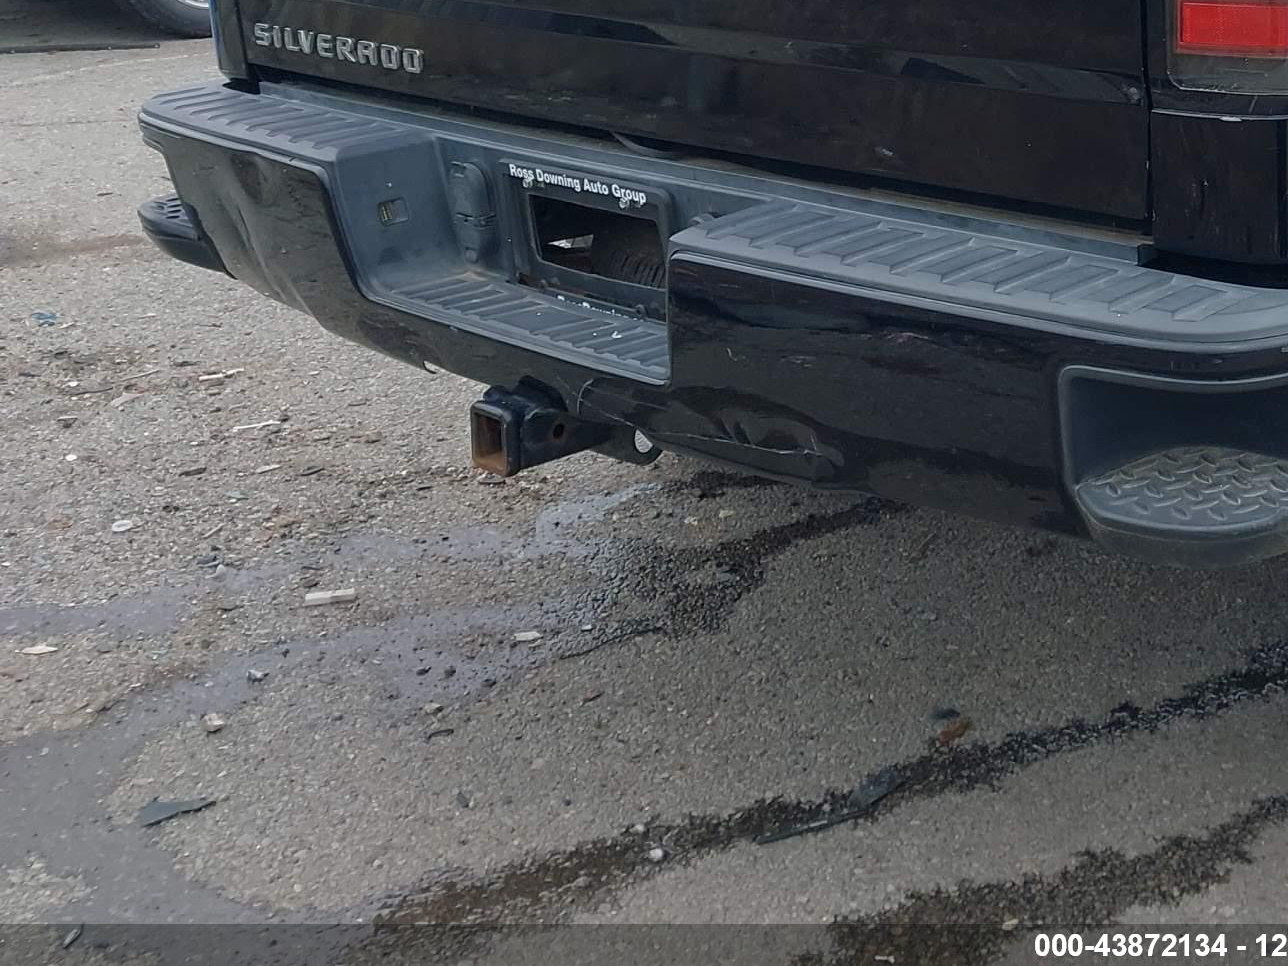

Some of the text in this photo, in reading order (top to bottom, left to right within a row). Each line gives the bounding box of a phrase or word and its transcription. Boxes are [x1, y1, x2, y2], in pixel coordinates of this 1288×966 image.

[253, 22, 424, 74] SILVERADO
[508, 163, 647, 205] Ross Downing Auto Group
